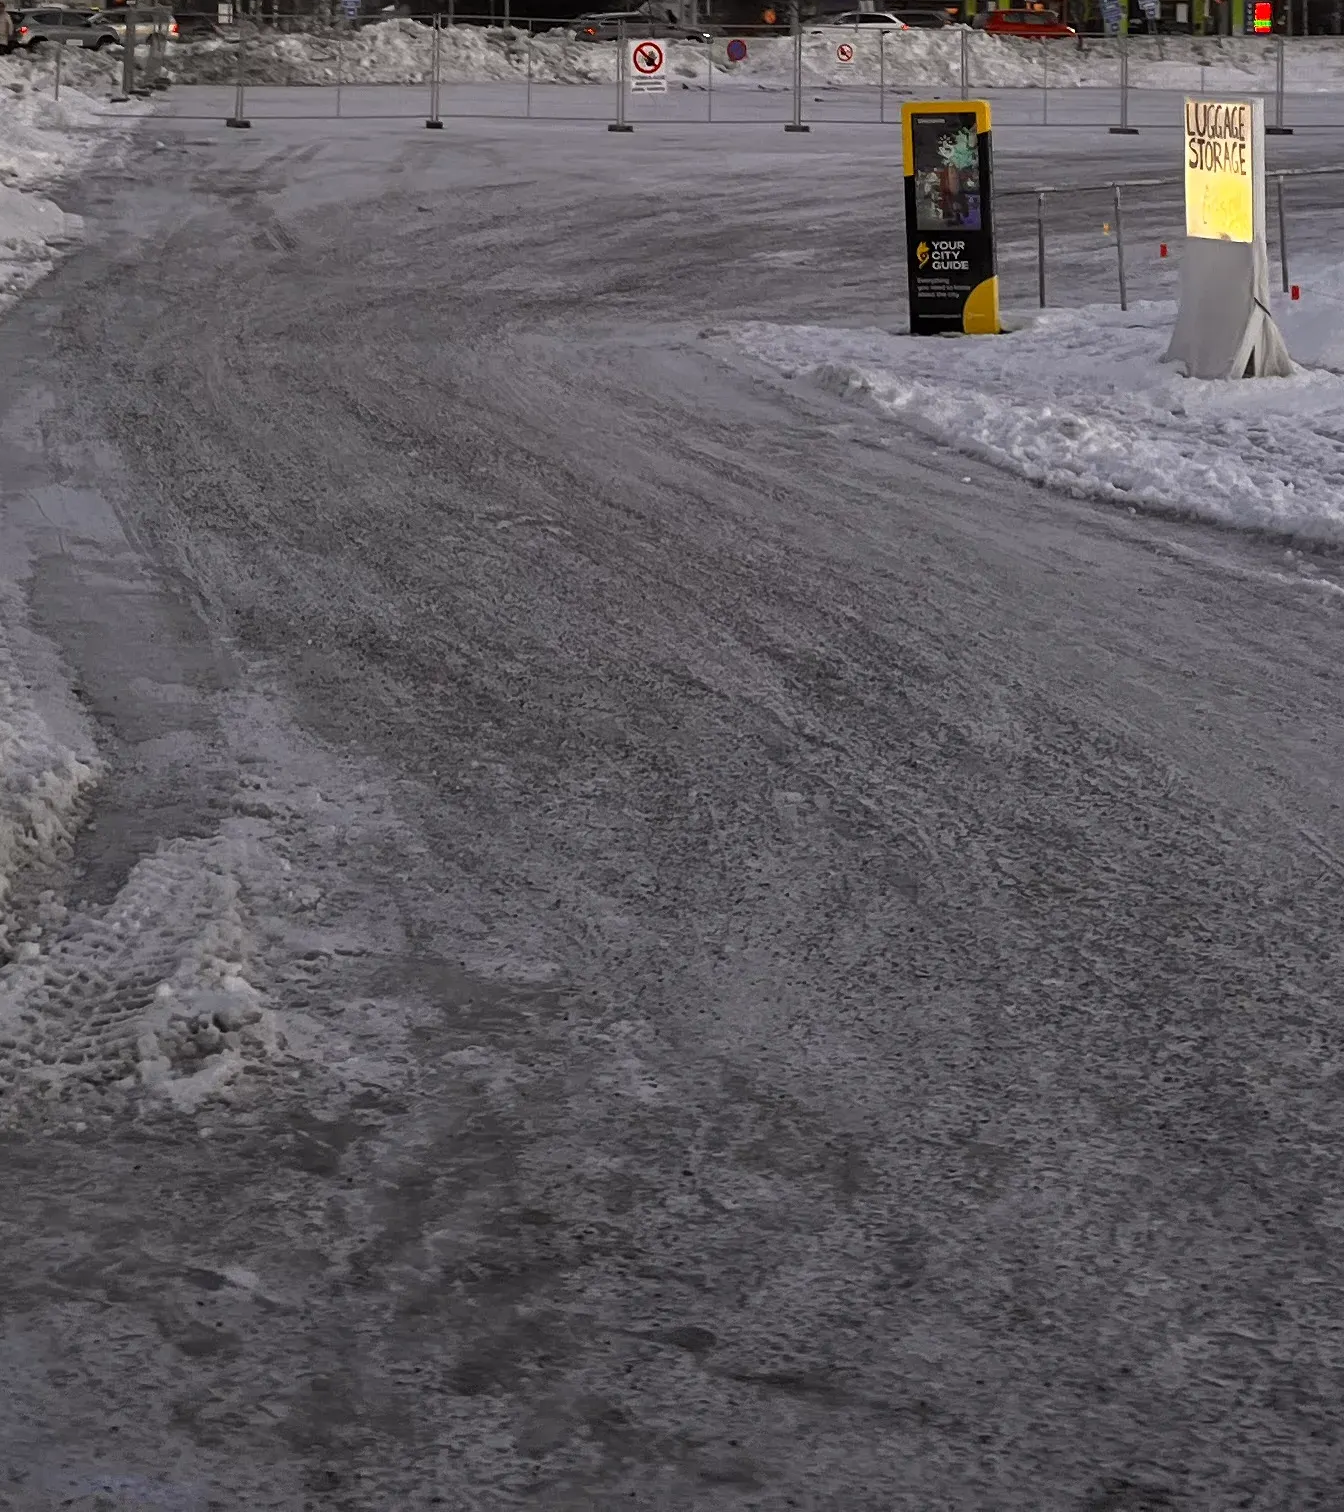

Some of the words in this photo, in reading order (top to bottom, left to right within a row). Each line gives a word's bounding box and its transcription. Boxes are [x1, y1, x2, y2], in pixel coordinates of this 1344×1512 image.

[1186, 103, 1245, 141] LUGGAGE
[1189, 138, 1246, 175] STORAGE
[931, 241, 965, 250] YOUR
[931, 251, 960, 260] CITY
[932, 261, 969, 270] GUIDE
